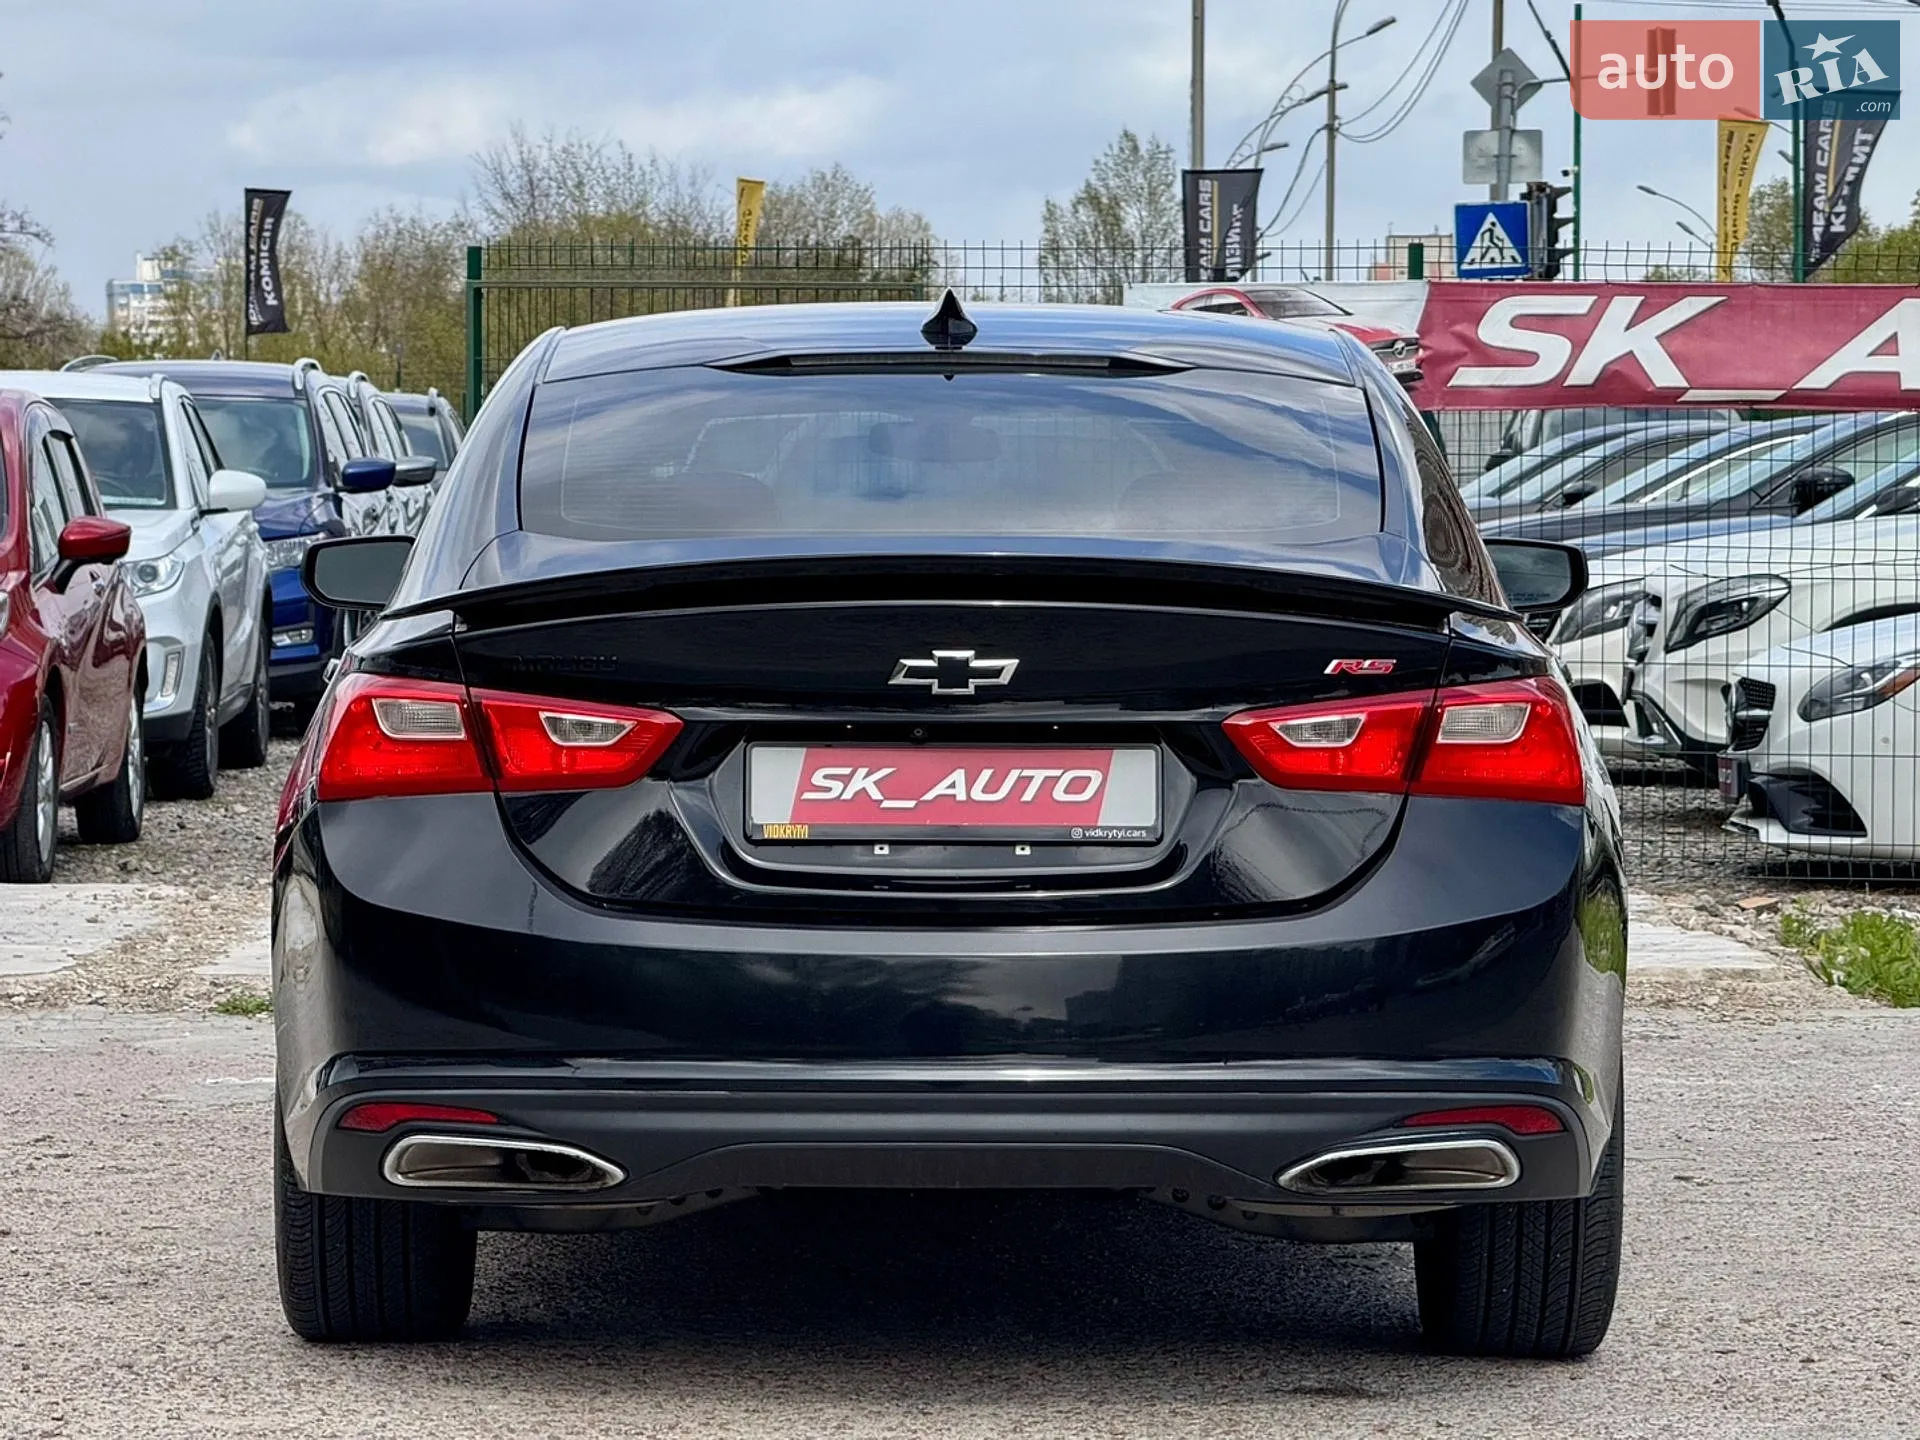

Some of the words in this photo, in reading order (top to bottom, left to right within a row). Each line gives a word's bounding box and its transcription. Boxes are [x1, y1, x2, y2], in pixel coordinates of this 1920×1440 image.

[1199, 179, 1212, 233] CARS
[1323, 658, 1397, 675] RS
[800, 767, 1104, 809] SK_AUTO
[762, 823, 809, 839] VIDKRYTYI
[1084, 827, 1147, 839] vidkrytyi.cars
